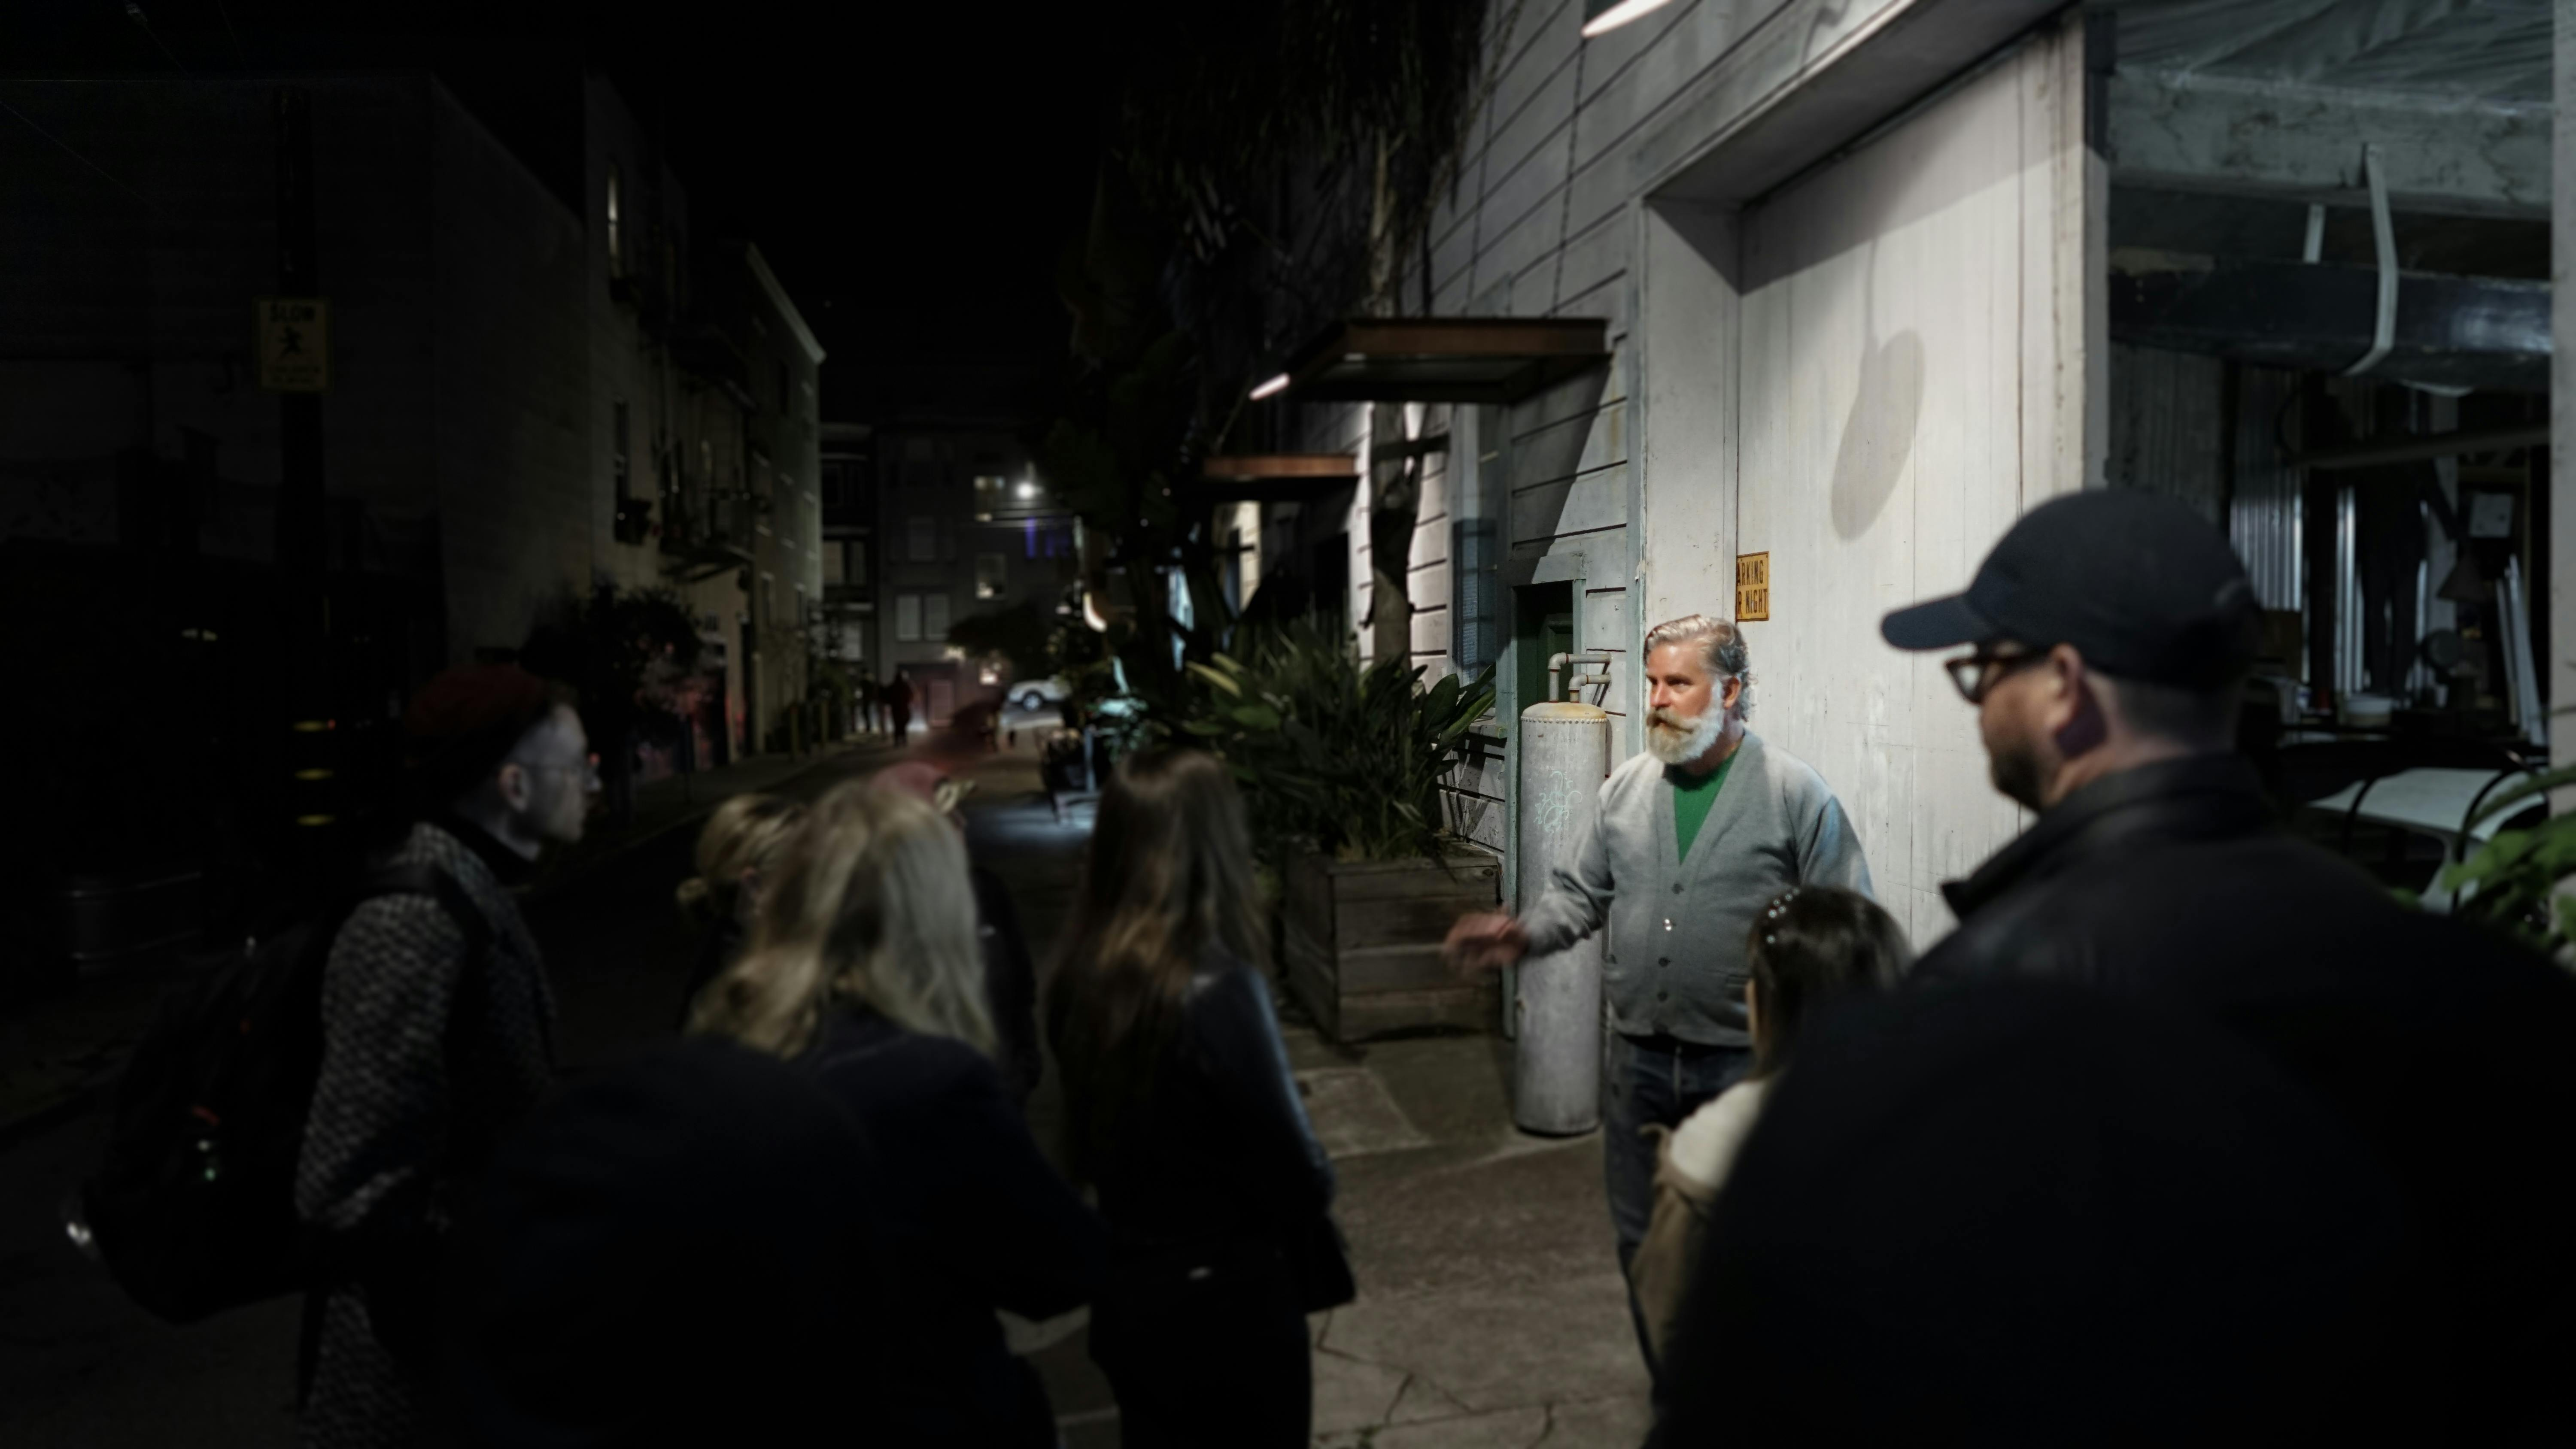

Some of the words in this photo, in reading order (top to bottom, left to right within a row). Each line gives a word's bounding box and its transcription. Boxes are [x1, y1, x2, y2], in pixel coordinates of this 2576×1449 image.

[1737, 560, 1763, 586] ARKING
[1737, 591, 1742, 614] R
[1746, 589, 1767, 614] NIGHT
